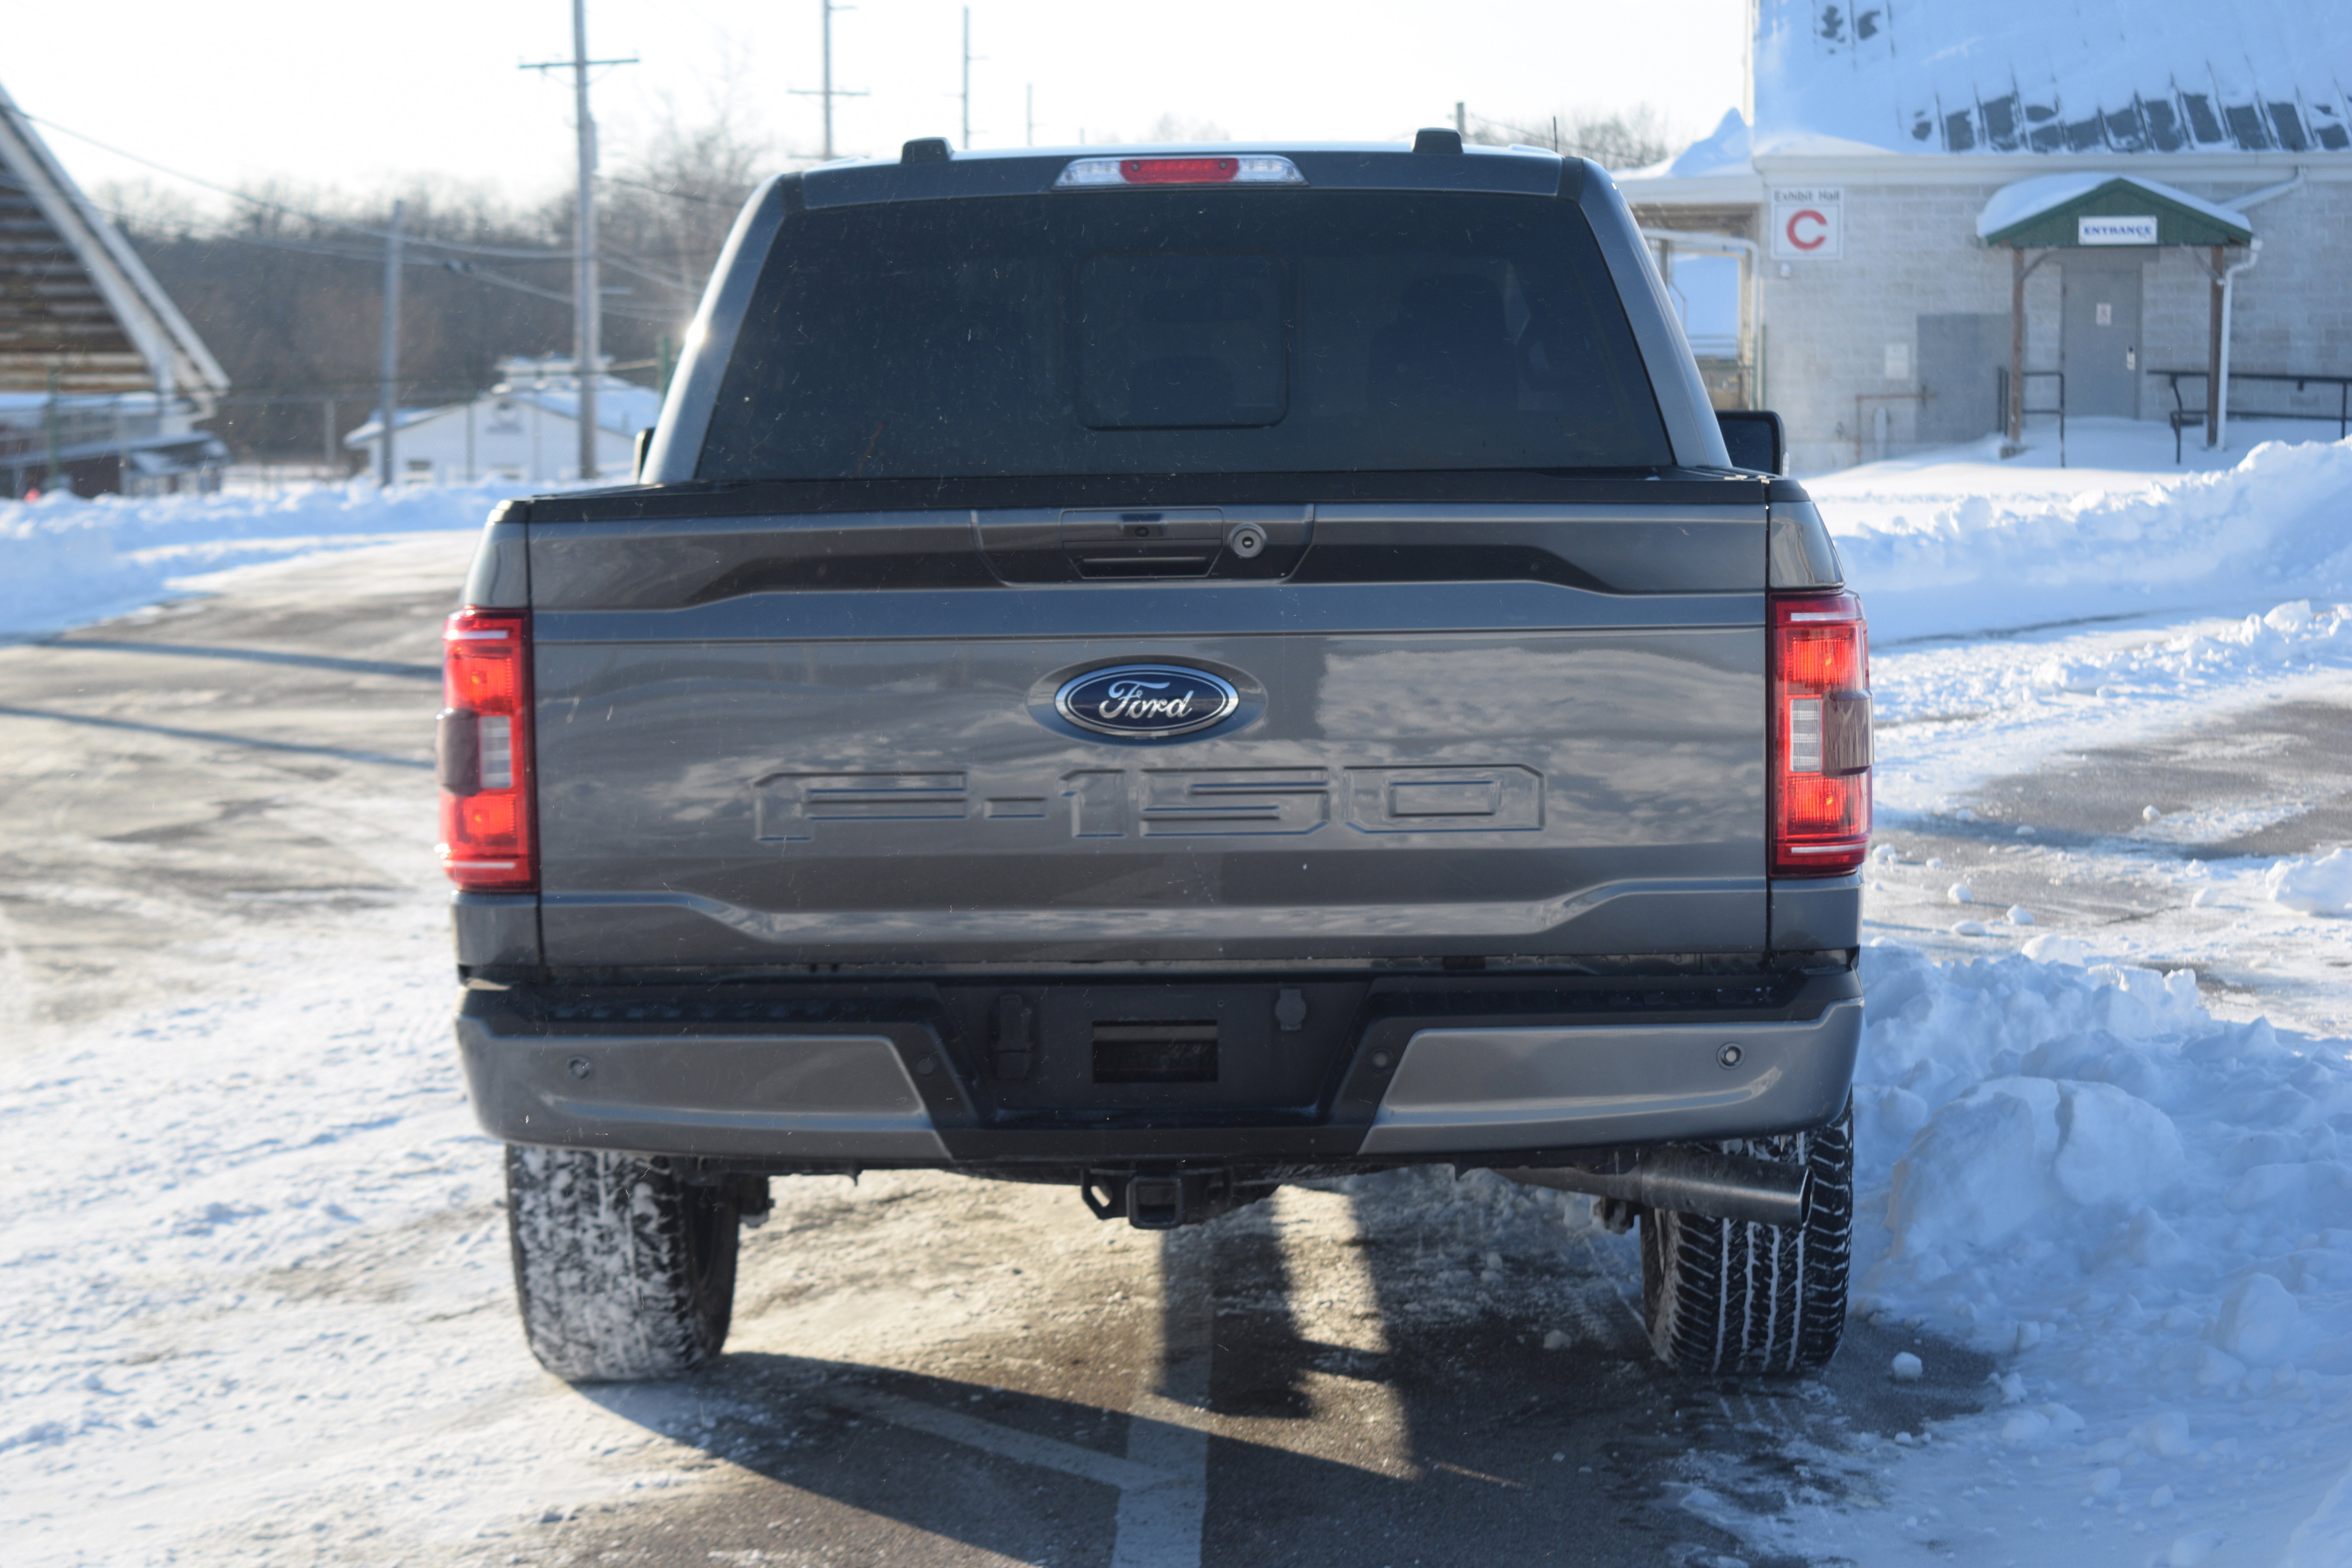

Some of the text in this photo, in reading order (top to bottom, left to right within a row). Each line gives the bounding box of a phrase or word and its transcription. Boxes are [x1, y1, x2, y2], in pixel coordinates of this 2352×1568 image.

[1774, 190, 1840, 201] Exhibit Hall
[1786, 209, 1827, 252] C
[2084, 225, 2152, 235] ENTRANCE
[1099, 680, 1194, 719] Ford
[754, 764, 1546, 841] F-150
